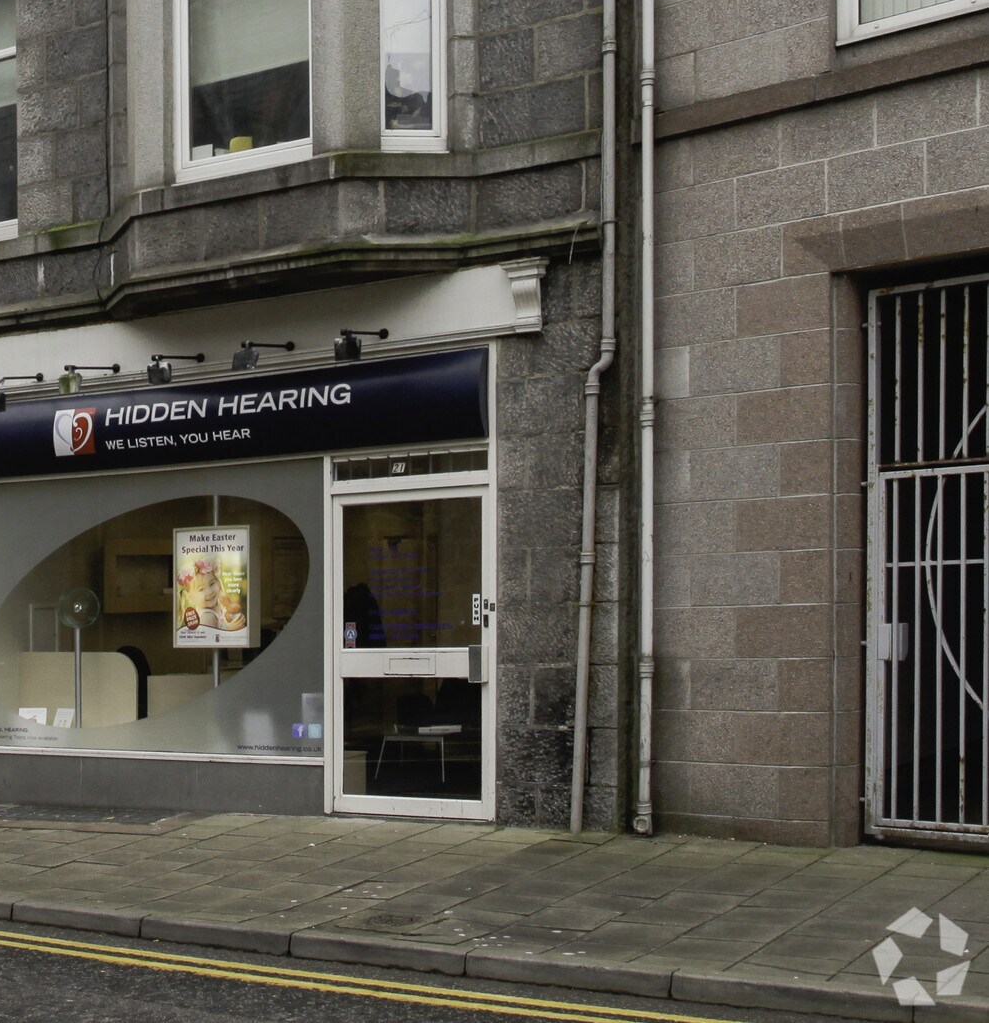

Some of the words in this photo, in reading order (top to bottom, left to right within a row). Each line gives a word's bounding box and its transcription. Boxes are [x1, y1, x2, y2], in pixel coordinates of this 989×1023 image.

[105, 398, 208, 426] HIDDEN
[217, 383, 352, 416] HEARING
[105, 440, 125, 450] WE
[127, 434, 177, 450] LISTEN,
[179, 433, 208, 444] YOU
[213, 428, 251, 442] HEAR
[393, 464, 404, 472] 21
[182, 545, 208, 555] Special
